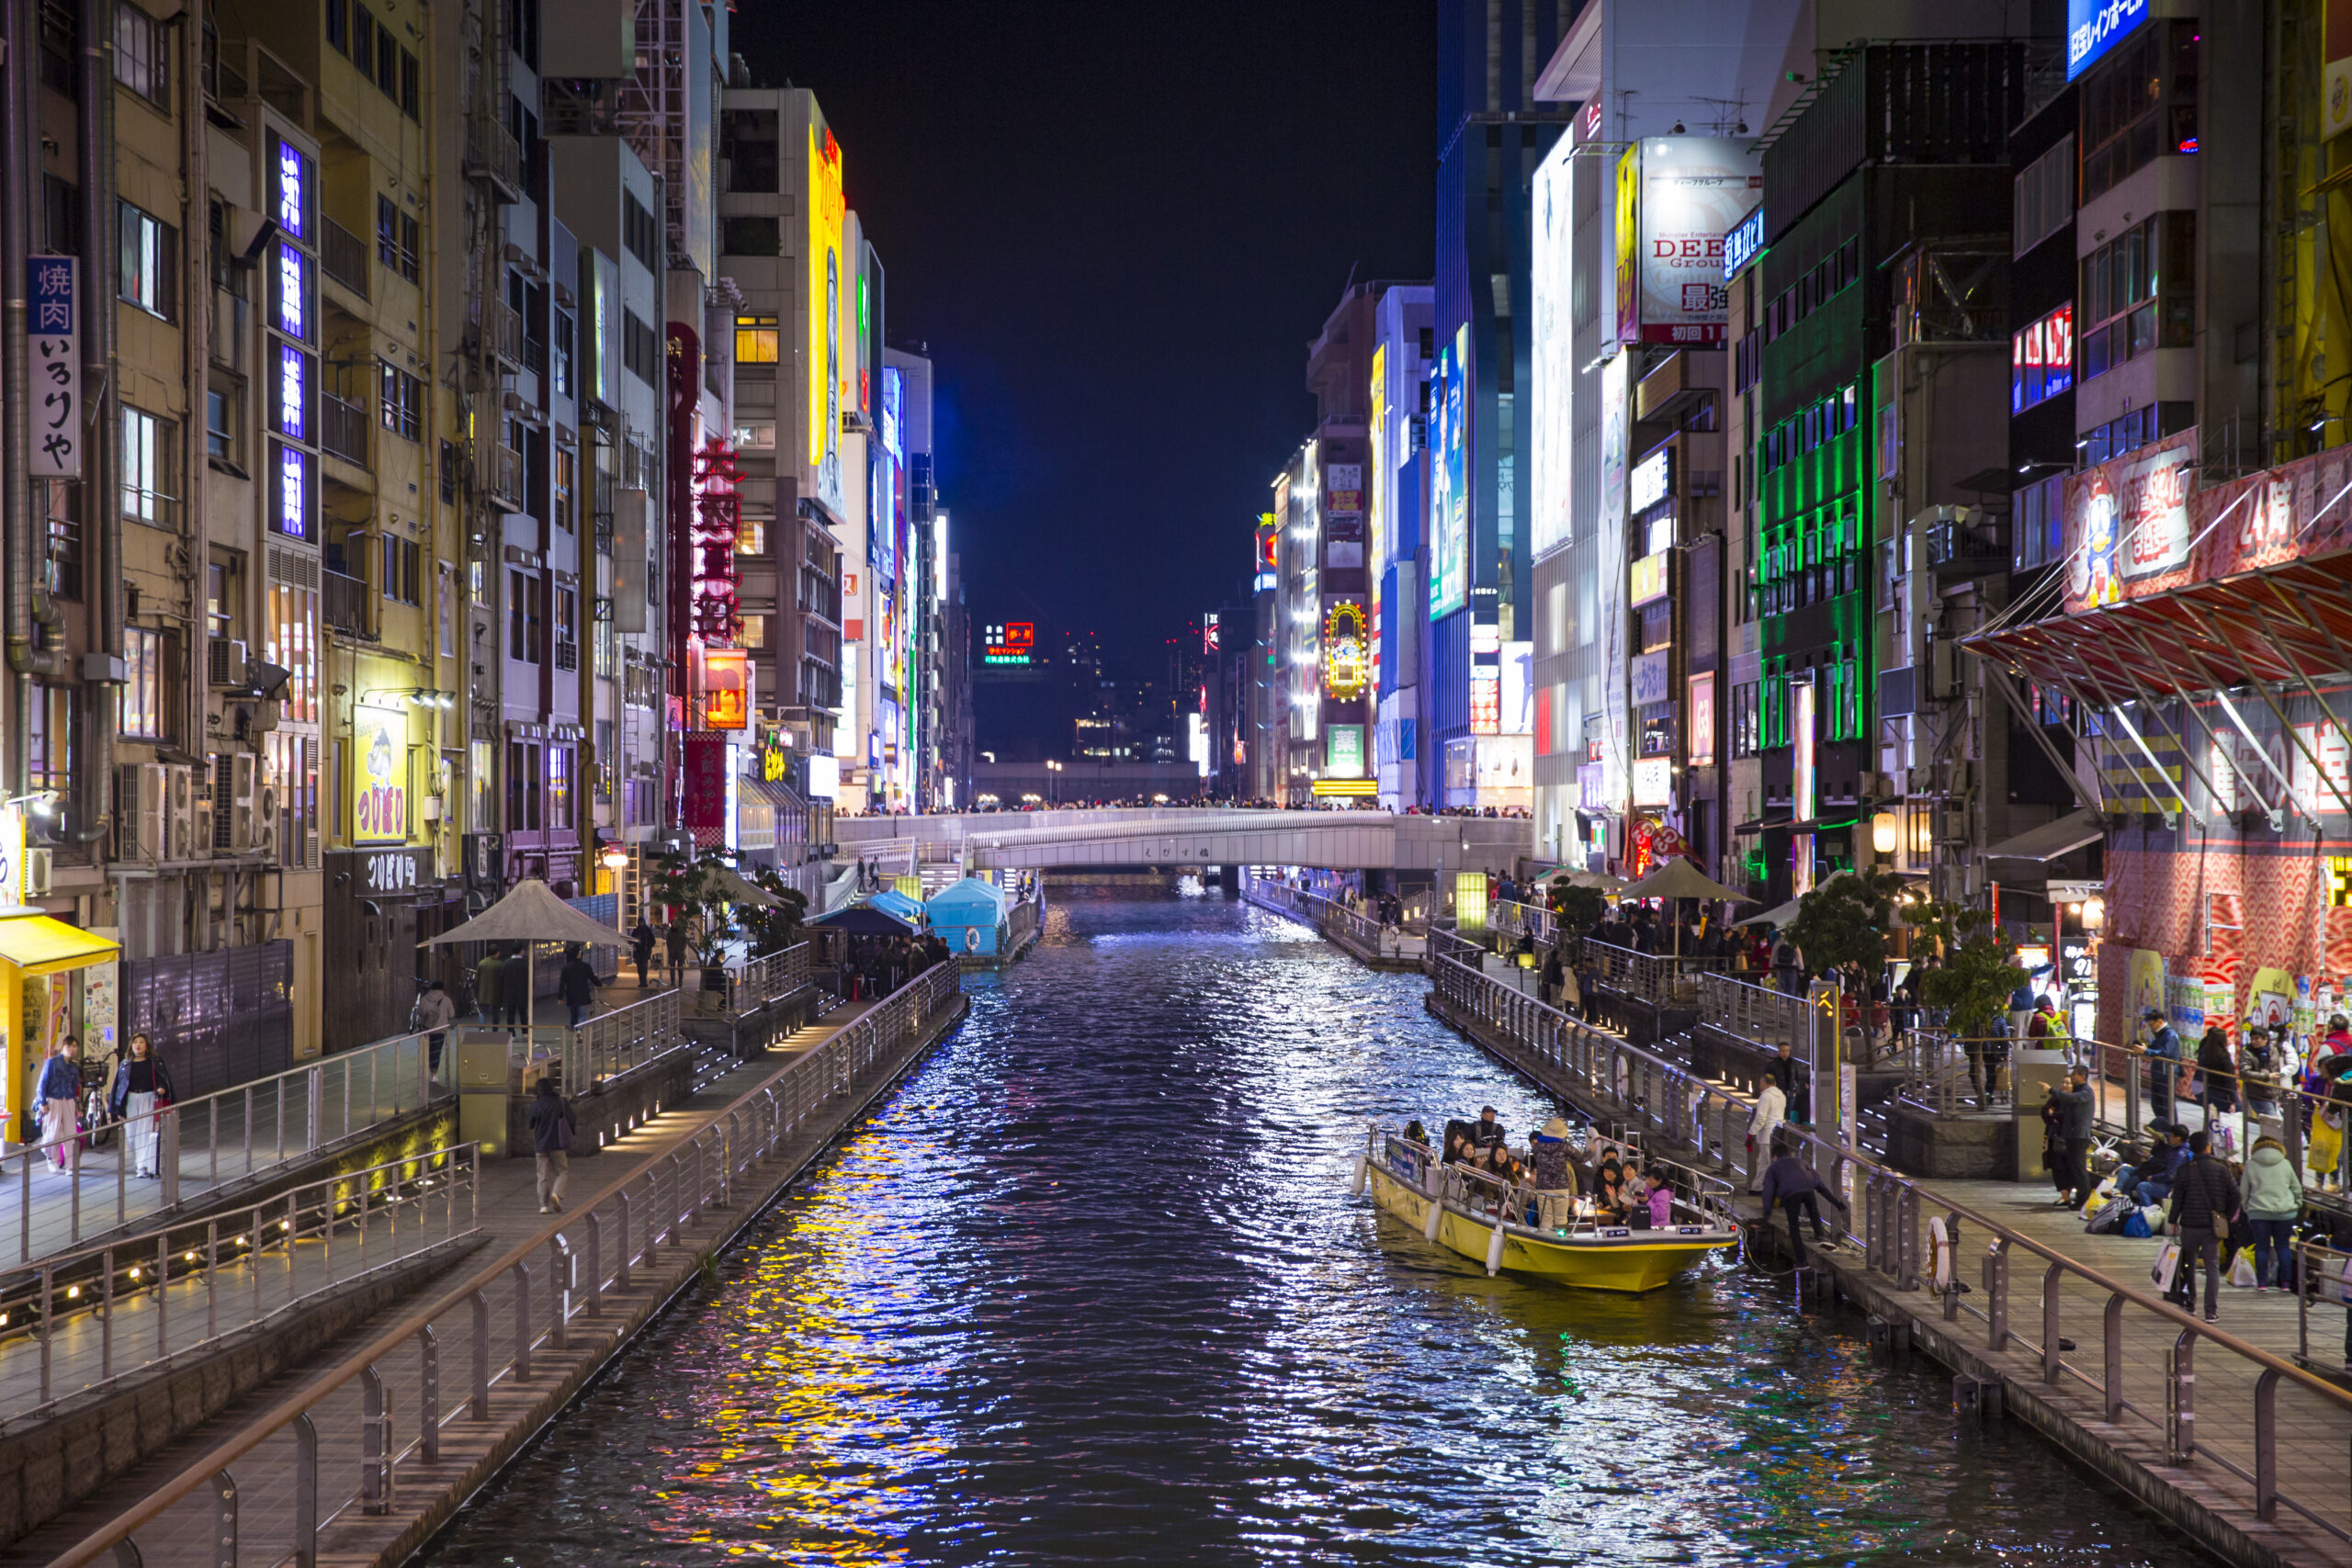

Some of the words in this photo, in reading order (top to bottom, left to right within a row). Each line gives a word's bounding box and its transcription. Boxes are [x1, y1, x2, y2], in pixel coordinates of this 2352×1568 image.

[1653, 240, 1725, 258] DEE
[38, 264, 71, 331] 焼肉
[40, 339, 73, 469] いろりや
[1697, 699, 1709, 739] G3
[701, 742, 716, 816] 大阪みやげ
[2211, 718, 2350, 816] 驚安の殿堂
[1632, 820, 1656, 845] G3
[1653, 829, 1679, 853] G3
[2329, 855, 2352, 908] ド
